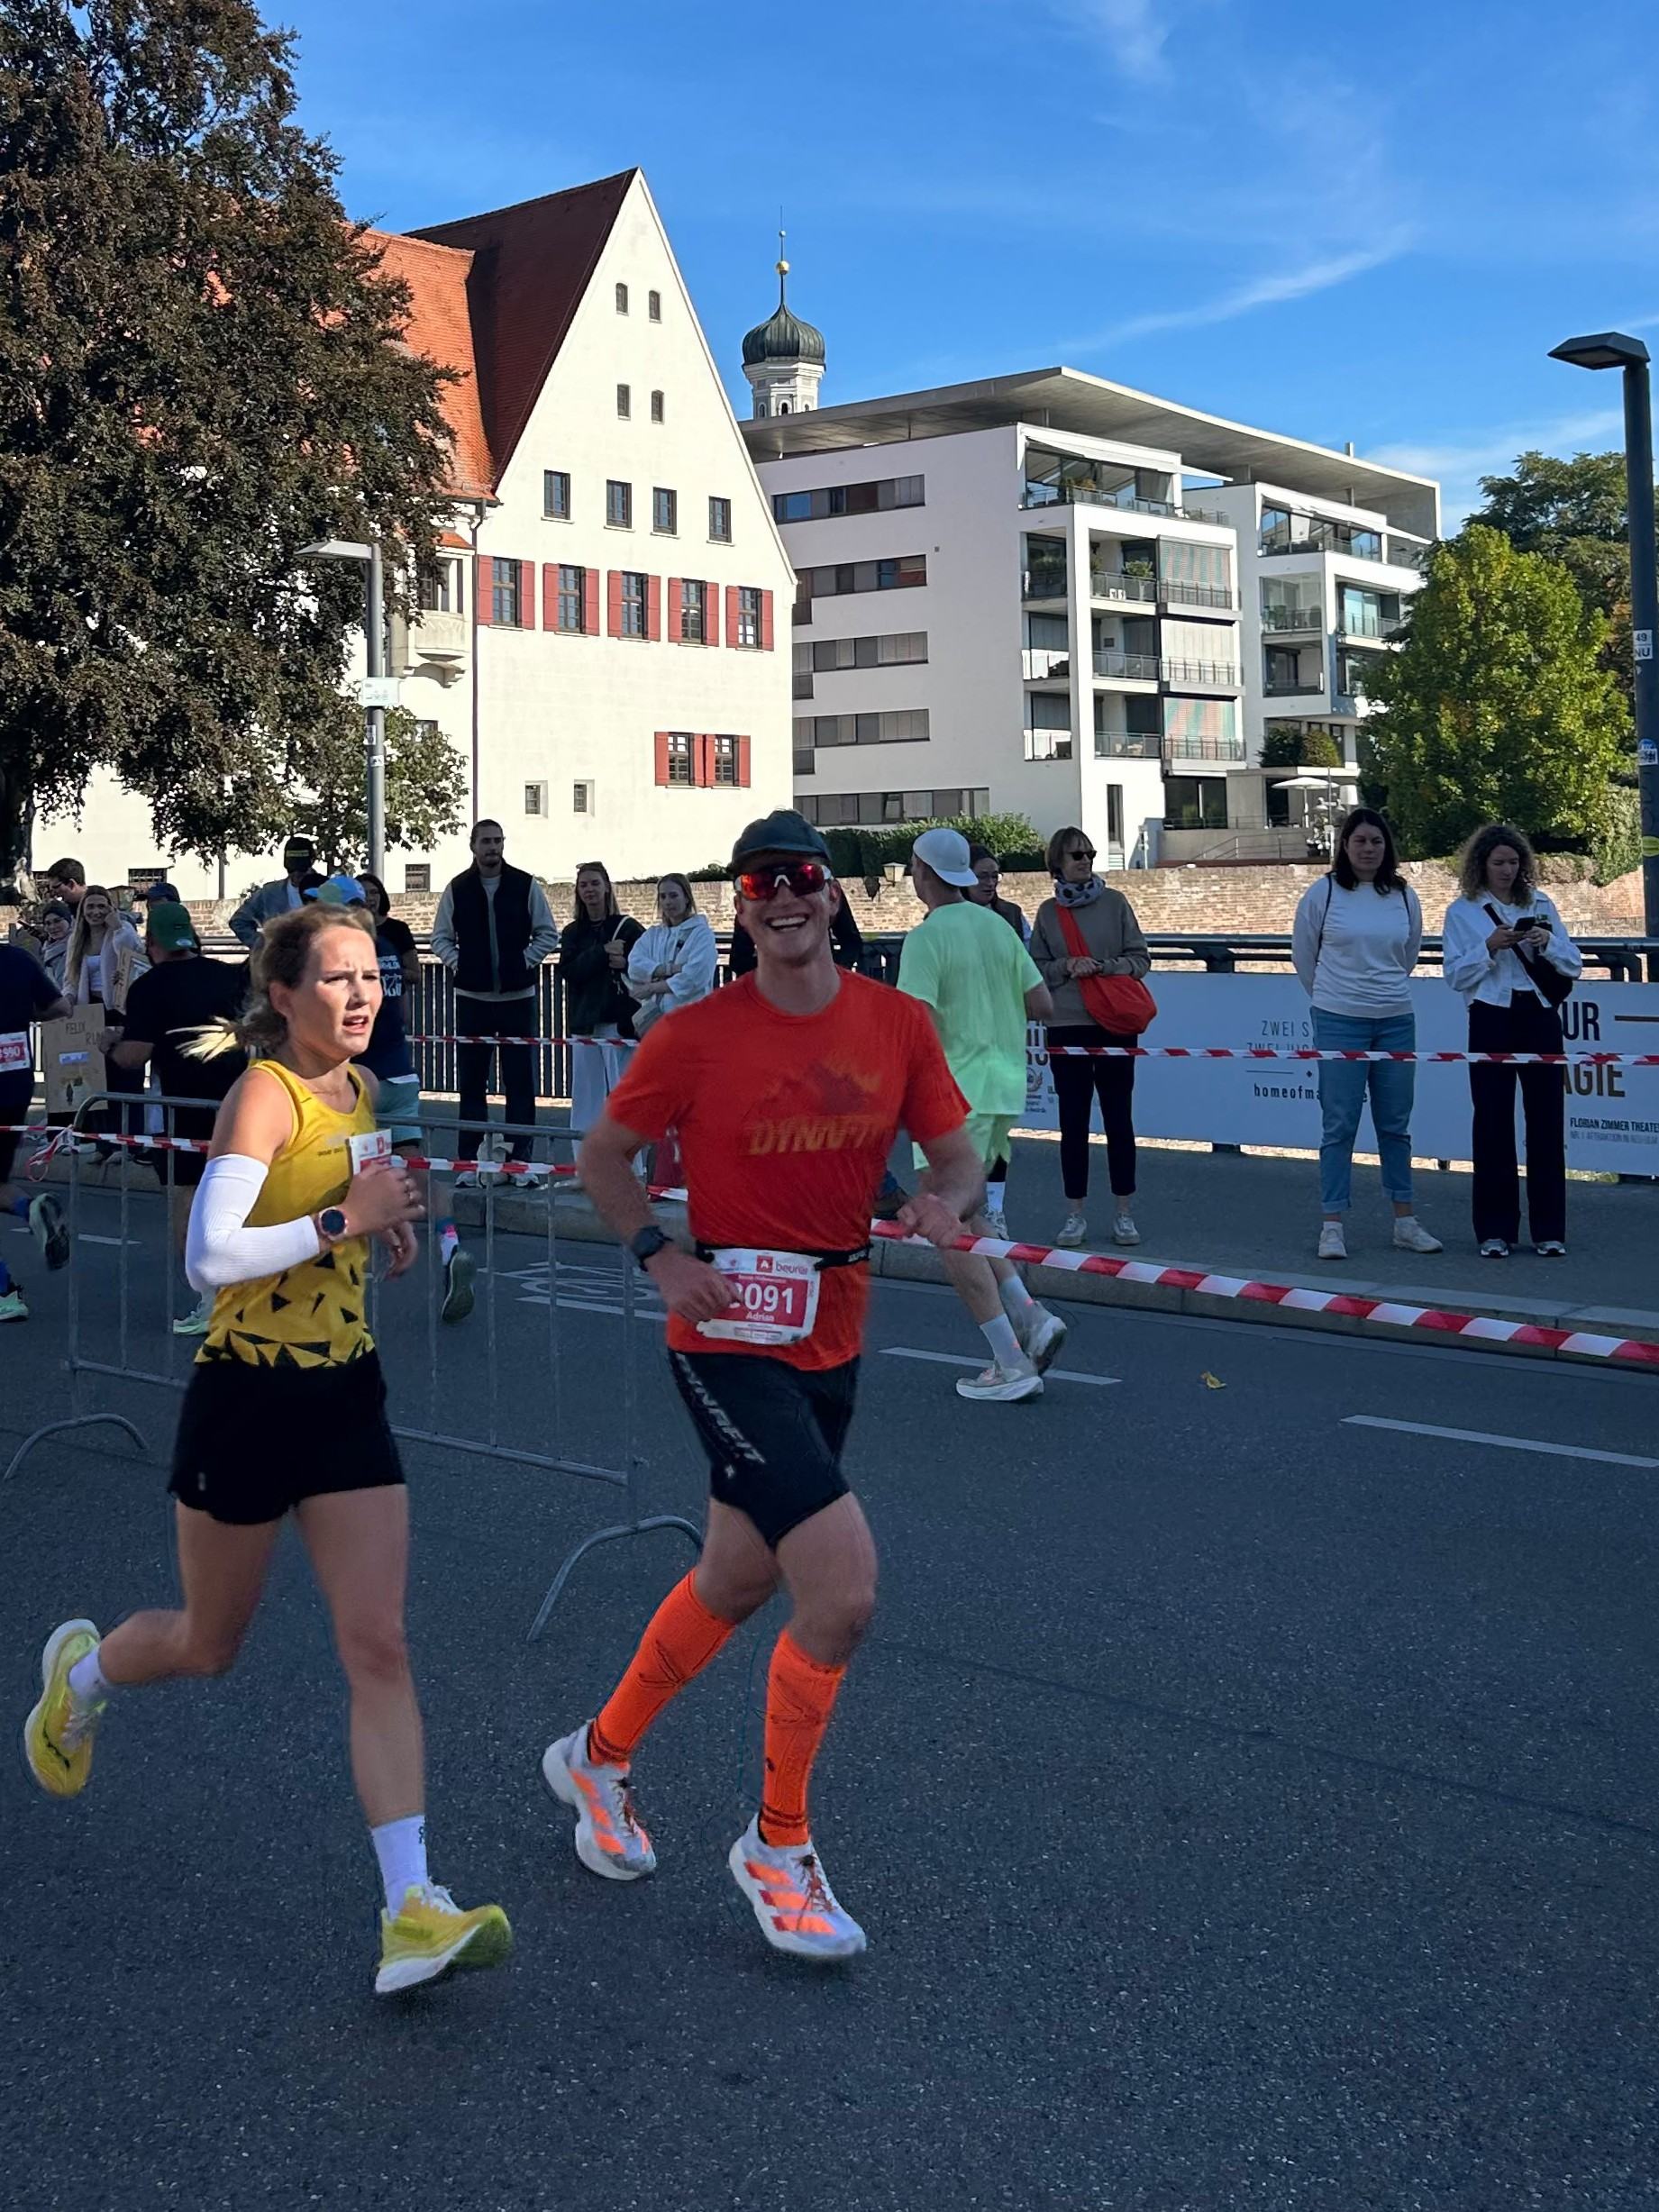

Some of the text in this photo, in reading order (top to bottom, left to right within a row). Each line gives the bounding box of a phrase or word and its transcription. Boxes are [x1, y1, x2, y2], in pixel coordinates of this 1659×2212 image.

[1262, 1020, 1294, 1037] ZWEI
[1570, 1117, 1600, 1128] FLORIAN
[1600, 1120, 1629, 1131] ZIMMER
[745, 1312, 775, 1323] Adrian
